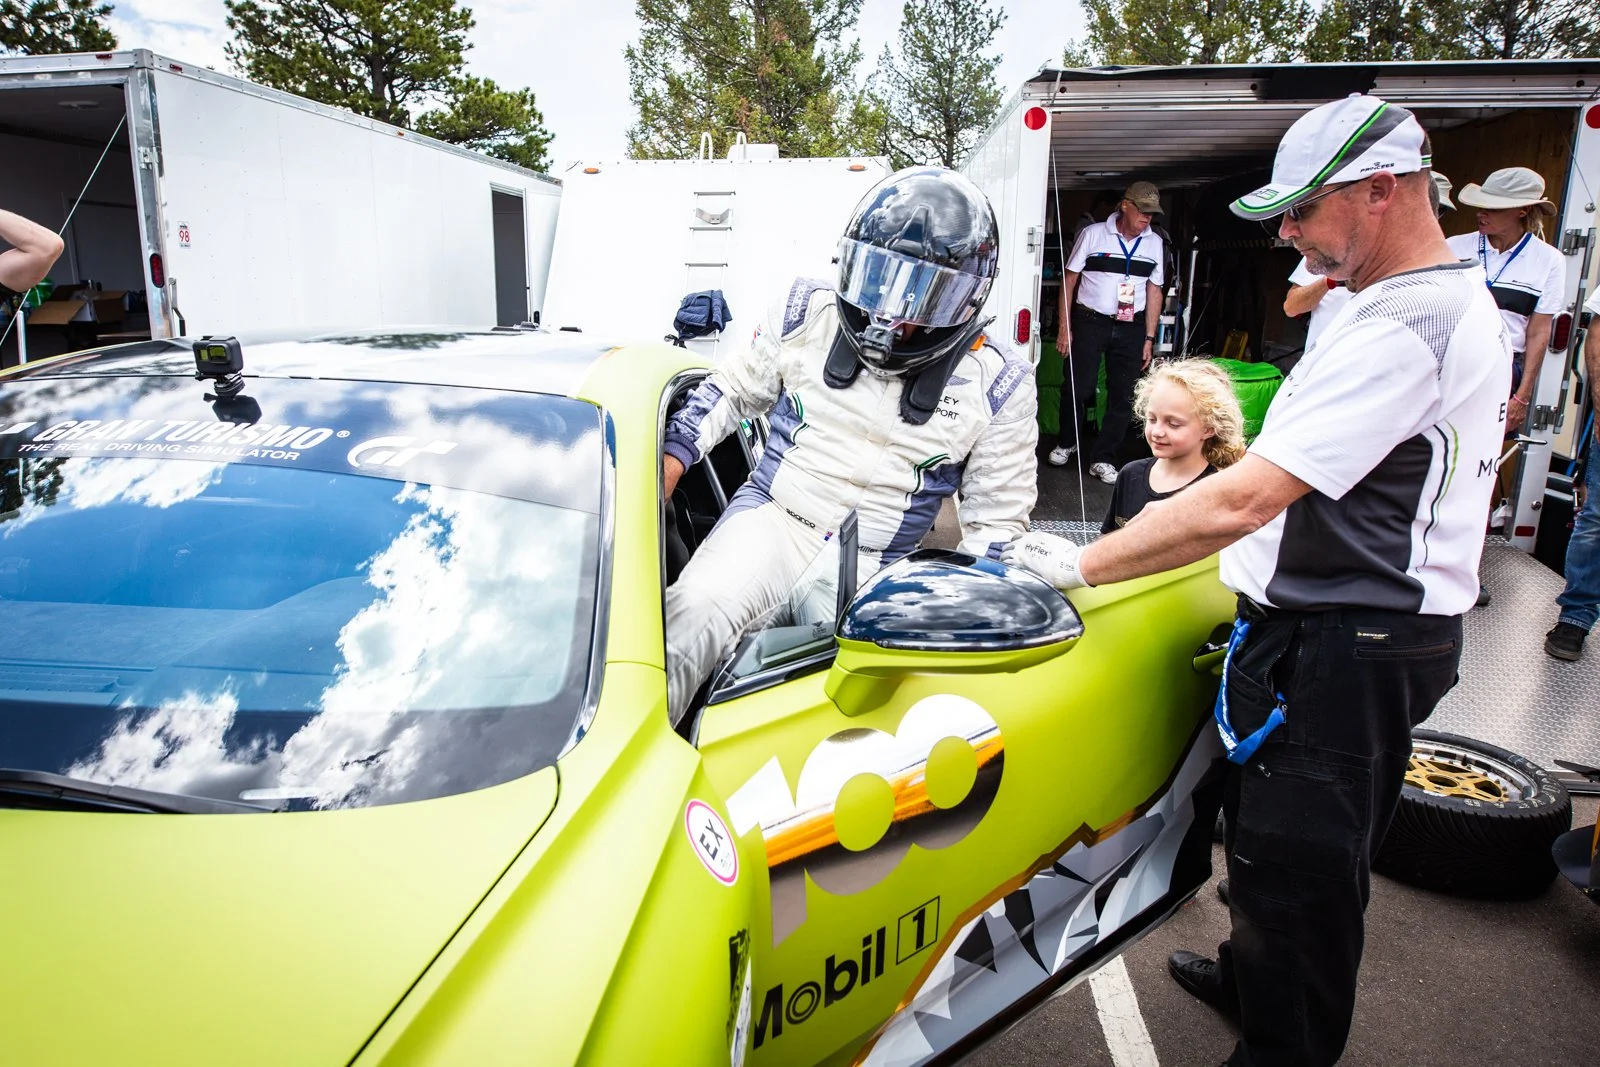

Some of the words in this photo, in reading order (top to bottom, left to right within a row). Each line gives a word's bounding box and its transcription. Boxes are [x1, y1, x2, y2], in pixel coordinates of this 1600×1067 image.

[32, 419, 155, 442] GRAN
[18, 443, 54, 452] THE
[55, 443, 101, 452] REAL
[104, 442, 181, 452] DRIVING
[182, 444, 300, 461] SIMULATOR
[1024, 543, 1048, 557] HyFlex
[699, 818, 723, 861] EX
